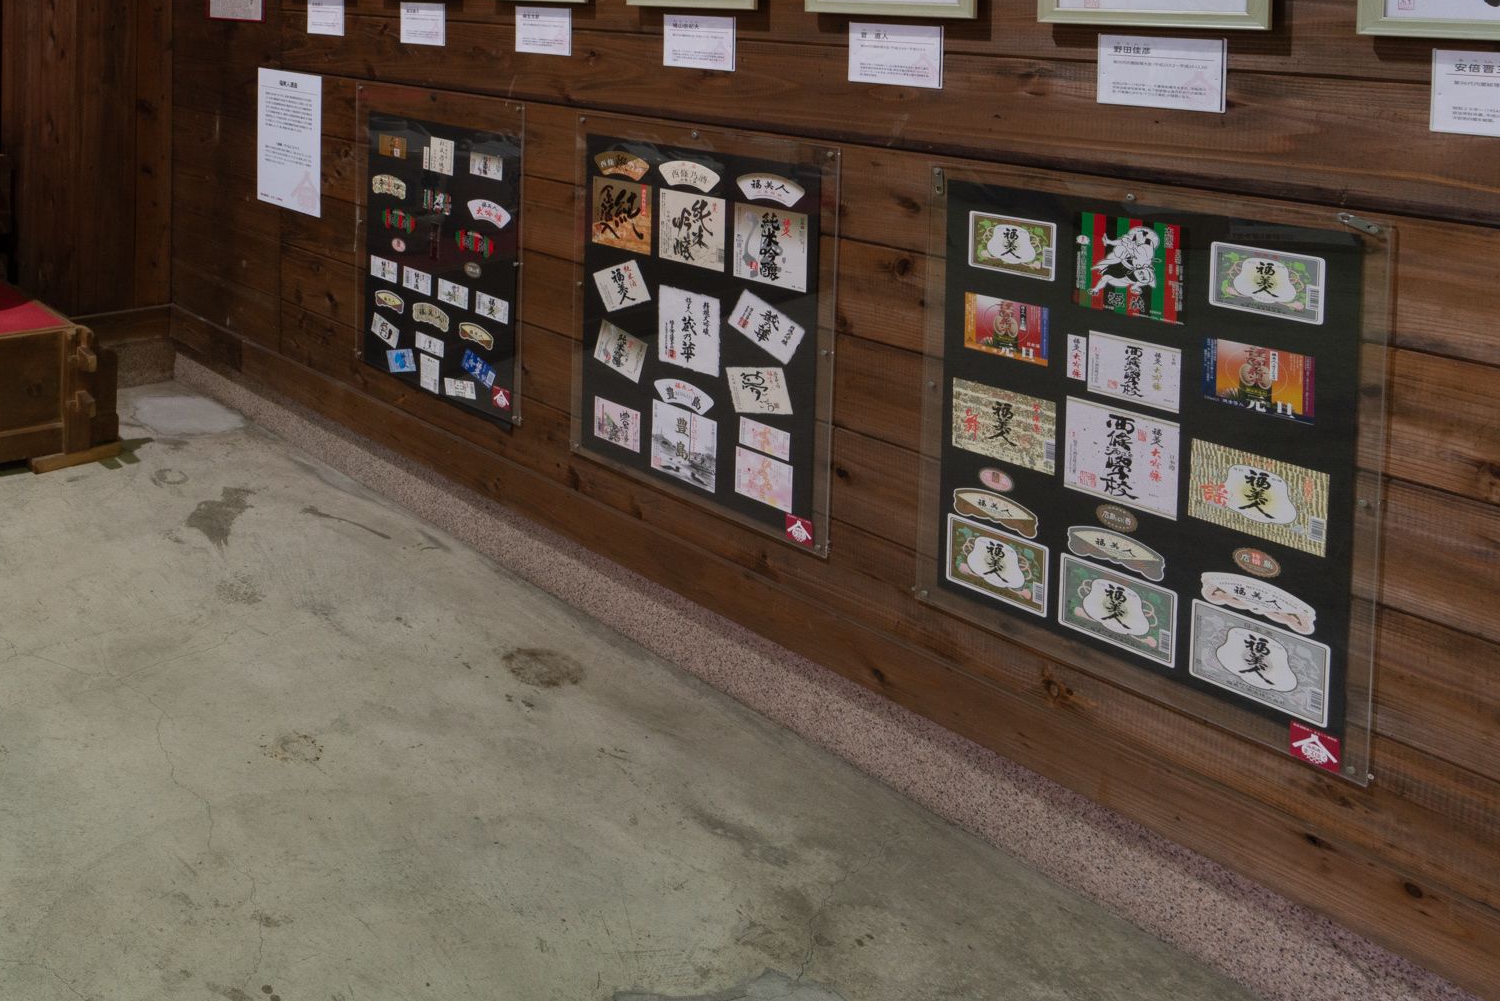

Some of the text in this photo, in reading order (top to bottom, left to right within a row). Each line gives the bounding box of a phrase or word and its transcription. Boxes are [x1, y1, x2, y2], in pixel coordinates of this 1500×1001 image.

[1113, 44, 1152, 55] 野田佳彦
[750, 179, 790, 195] 福美人
[758, 211, 781, 282] 純米吟醸
[1001, 227, 1022, 260] 福美人
[610, 268, 637, 305] 福美人
[1252, 261, 1280, 299] 福美人
[988, 400, 1018, 447] 福美人
[978, 498, 1014, 519] 福美人
[1238, 468, 1276, 520] 福美人
[984, 540, 1009, 584] 福美人
[1094, 537, 1136, 558] 福美人
[1101, 584, 1133, 630] 福美人
[1234, 584, 1282, 611] 福美人
[1238, 633, 1275, 686] 福美人
